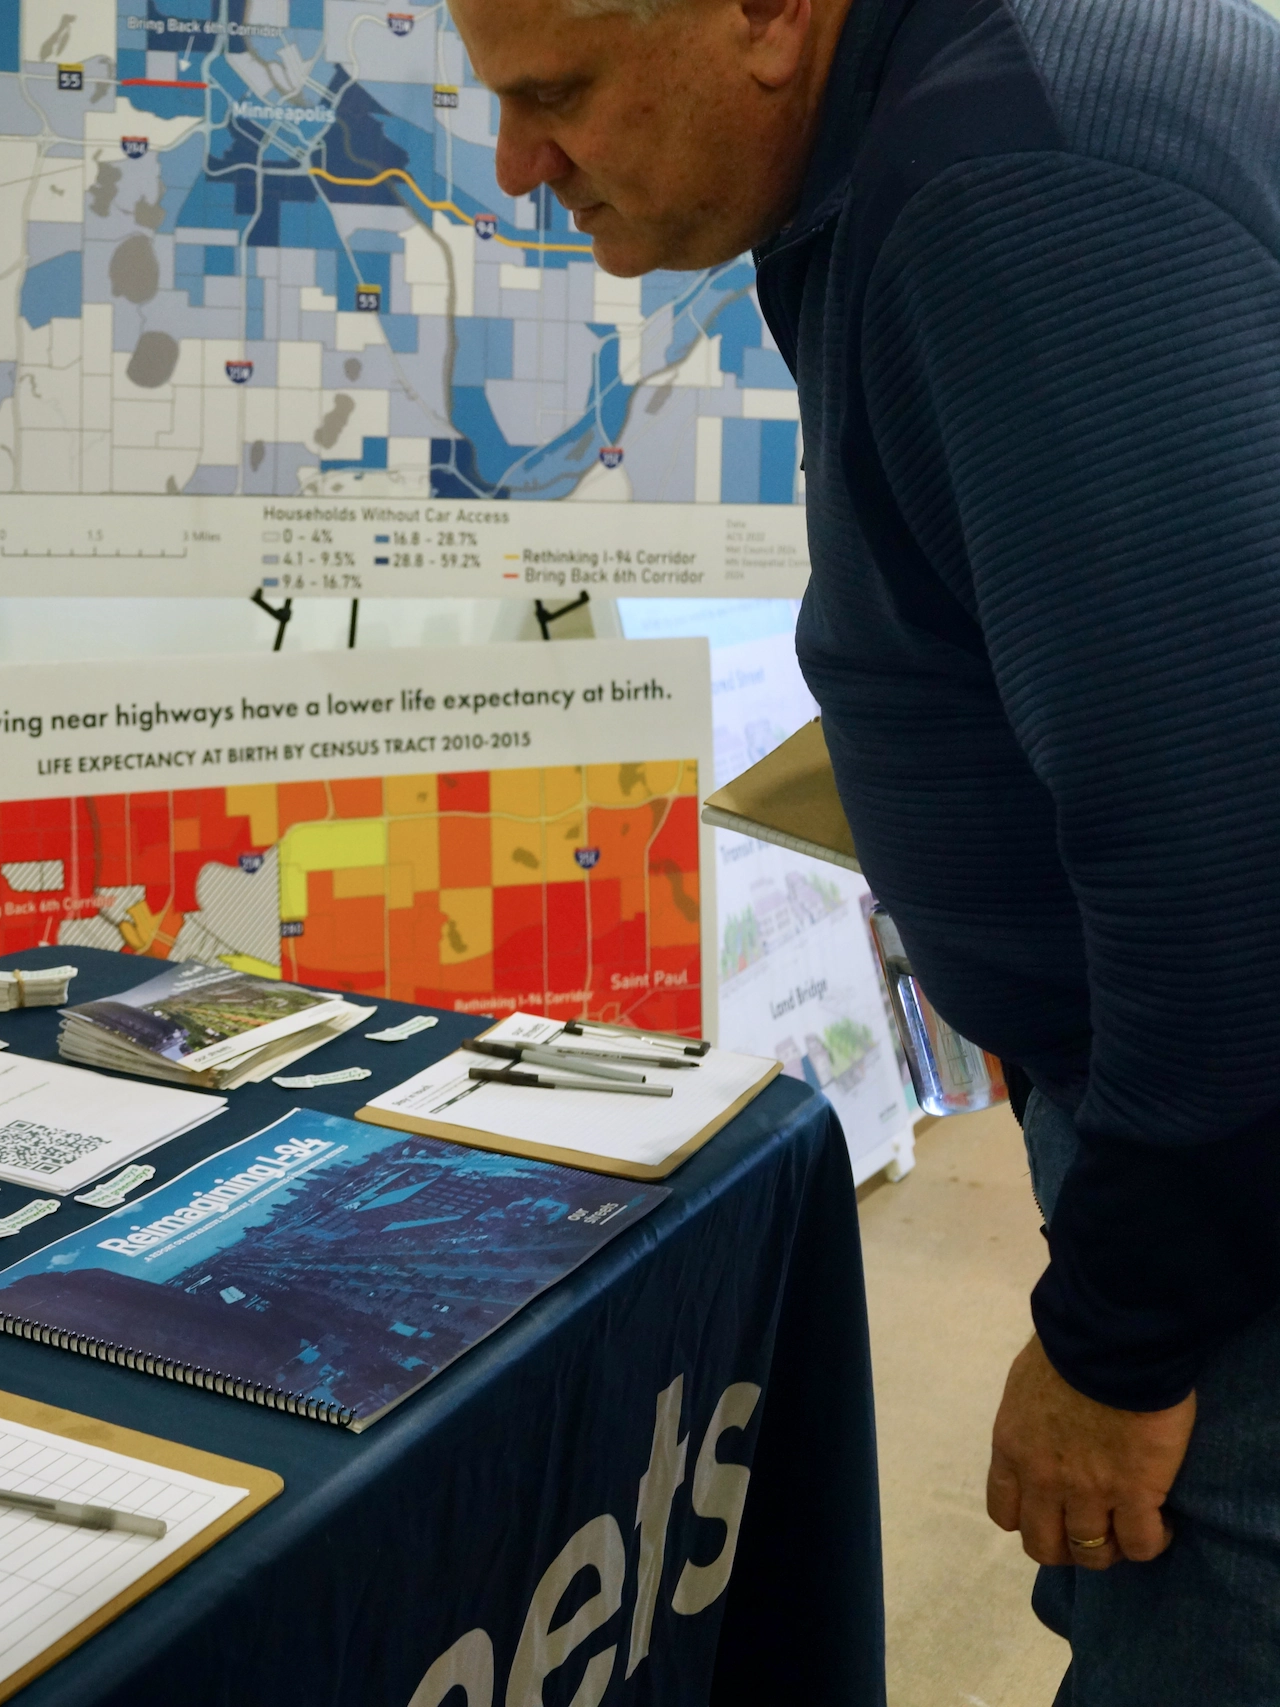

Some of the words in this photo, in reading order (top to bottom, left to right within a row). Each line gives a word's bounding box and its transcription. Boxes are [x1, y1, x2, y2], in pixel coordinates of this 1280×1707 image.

[127, 16, 165, 34] Bring
[167, 18, 201, 33] Back
[60, 72, 81, 88] 55
[231, 102, 336, 124] Minneapolis
[476, 221, 495, 233] 94
[358, 294, 378, 309] 55
[263, 506, 357, 523] Households
[361, 507, 421, 524] Without
[425, 508, 453, 524] Car
[458, 508, 510, 525] Access
[283, 530, 293, 545] 0
[311, 530, 333, 545] 4%
[393, 531, 421, 546] 16.8
[437, 532, 478, 547] 28.7%
[283, 553, 305, 567] 4.1
[321, 552, 356, 568] 9.5%
[393, 553, 422, 568] 28.8
[439, 554, 481, 569] 59.2%
[524, 550, 599, 566] Rethinking
[603, 550, 632, 565] I-94
[636, 550, 696, 565] Corridor
[283, 576, 306, 590] 9.6
[323, 575, 362, 591] 16.7%
[525, 568, 567, 586] Bring
[570, 568, 608, 584] Back
[613, 569, 635, 584] 6th
[640, 569, 706, 584] Corridor
[51, 711, 108, 731] near
[116, 702, 235, 732] highways
[241, 697, 299, 720] have
[306, 701, 320, 717] a
[327, 693, 393, 715] lower
[401, 689, 436, 712] life
[443, 687, 576, 716] expectancy
[583, 683, 605, 703] at
[611, 678, 673, 702] birth.
[37, 757, 73, 776] LIFE
[78, 750, 197, 773] EXPECTANCY
[202, 748, 223, 765] AT
[227, 744, 278, 764] BIRTH
[284, 743, 305, 760] BY
[311, 740, 379, 758] CENSUS
[385, 735, 437, 754] TRACT
[442, 731, 532, 752] 2010-2015
[5, 900, 37, 917] Back
[610, 972, 650, 990] Saint
[654, 969, 688, 986] Paul
[771, 994, 794, 1020] Land
[96, 1161, 286, 1257] Reimagining
[256, 1137, 328, 1170] I-94
[568, 1208, 584, 1221] our
[584, 1202, 619, 1224] streets
